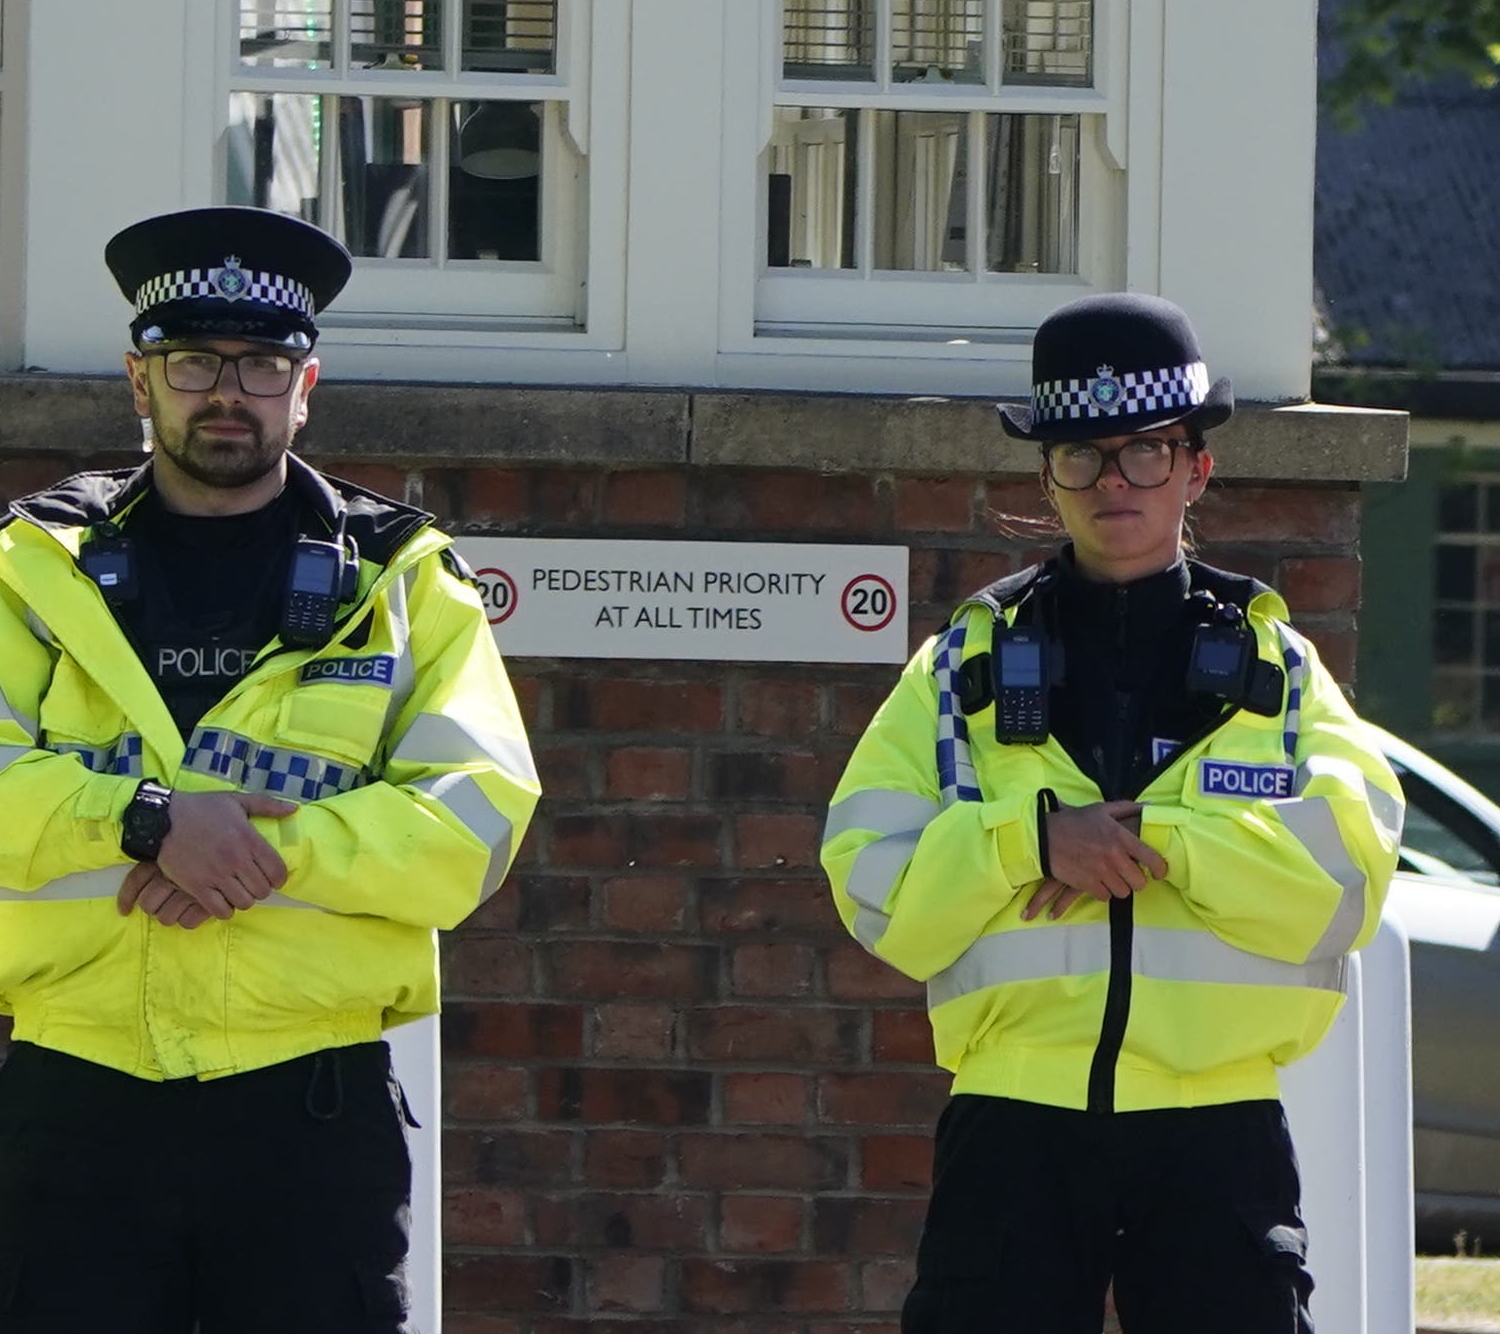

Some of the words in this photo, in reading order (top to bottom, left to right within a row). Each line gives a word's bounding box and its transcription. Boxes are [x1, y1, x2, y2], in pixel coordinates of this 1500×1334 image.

[533, 569, 694, 593] PEDESTRIAN
[704, 572, 826, 595] PRIORITY
[851, 588, 888, 615] 20
[595, 606, 630, 628] AT
[634, 606, 682, 629] ALL
[687, 607, 762, 630] TIMES
[307, 659, 389, 679] POLICE
[1208, 768, 1289, 796] POLICE
